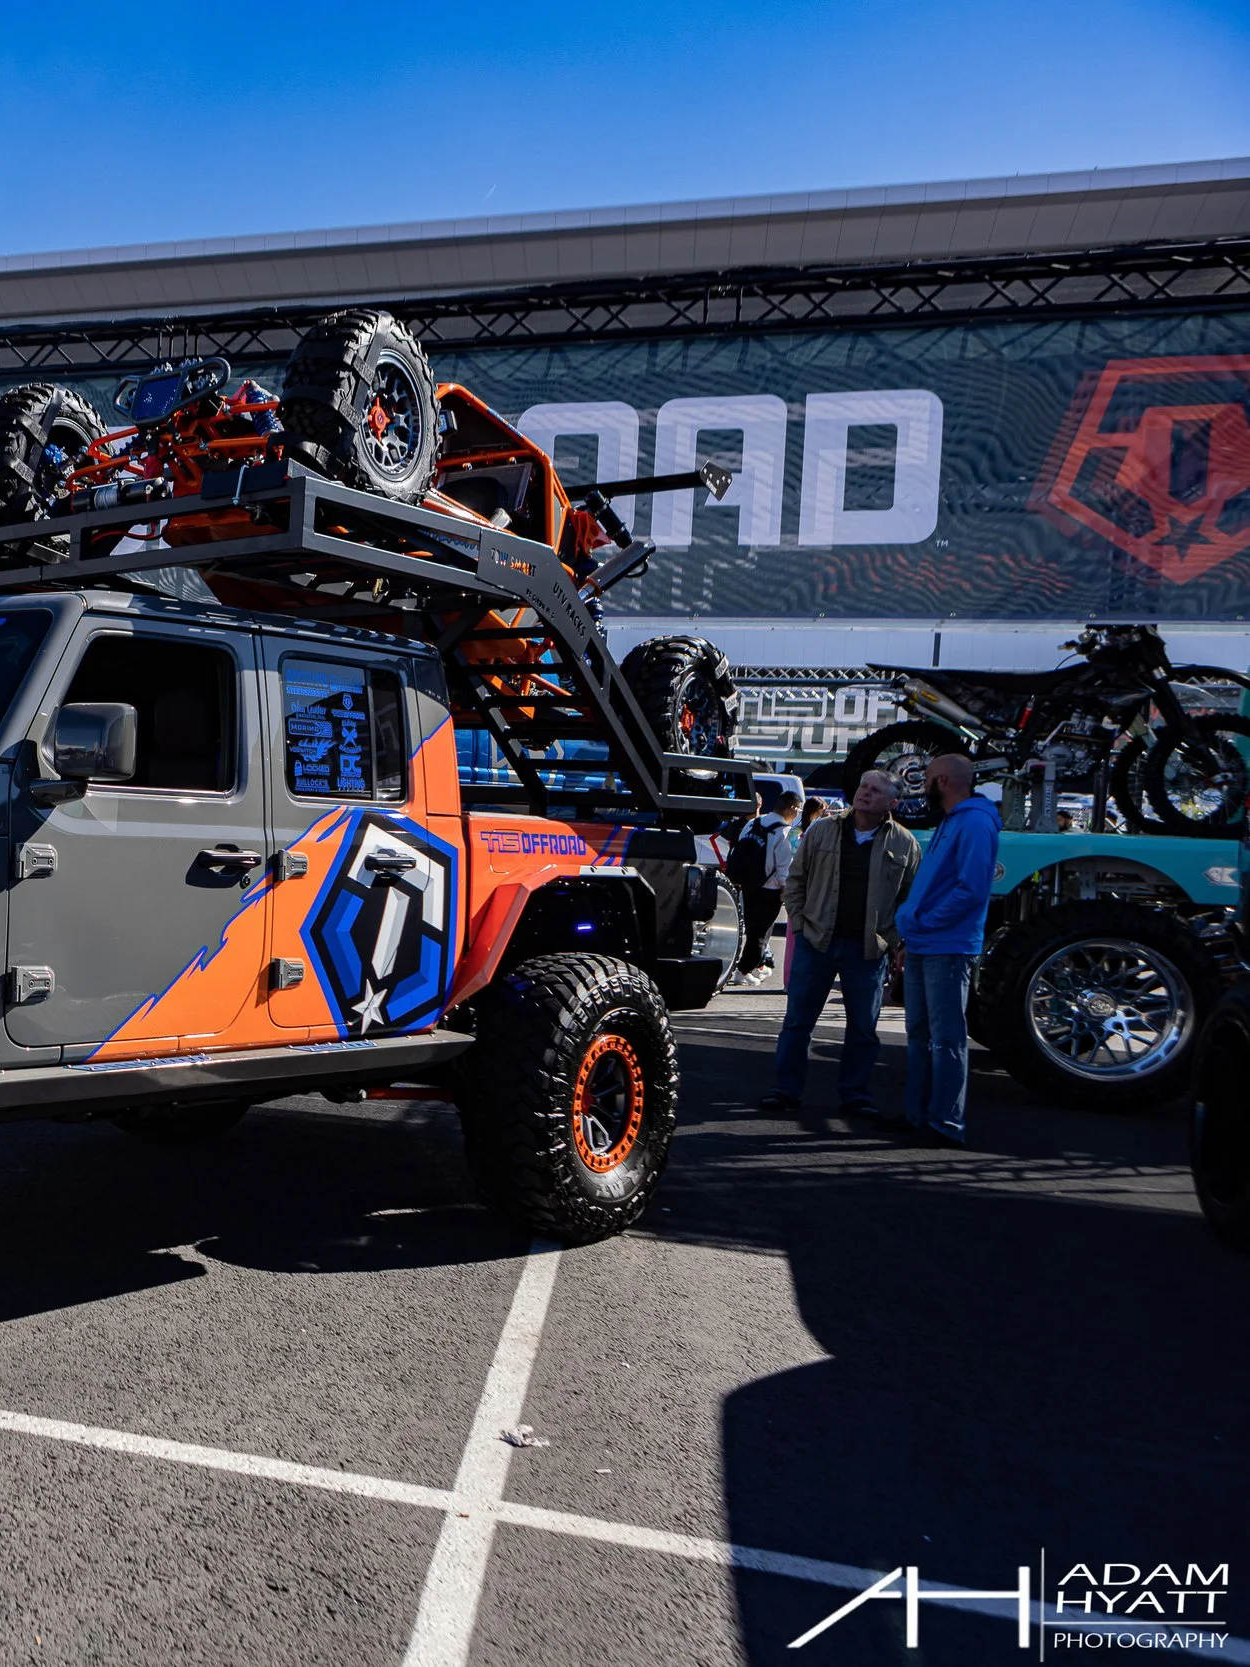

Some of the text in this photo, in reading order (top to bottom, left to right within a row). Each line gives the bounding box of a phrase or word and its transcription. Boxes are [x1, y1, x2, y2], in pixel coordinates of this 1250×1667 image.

[491, 547, 537, 578] TOW SMART
[553, 581, 587, 639] UTV RACKS
[303, 764, 330, 773] LOCKED
[337, 777, 366, 788] LIGHTING
[522, 833, 587, 856] OFFROAD
